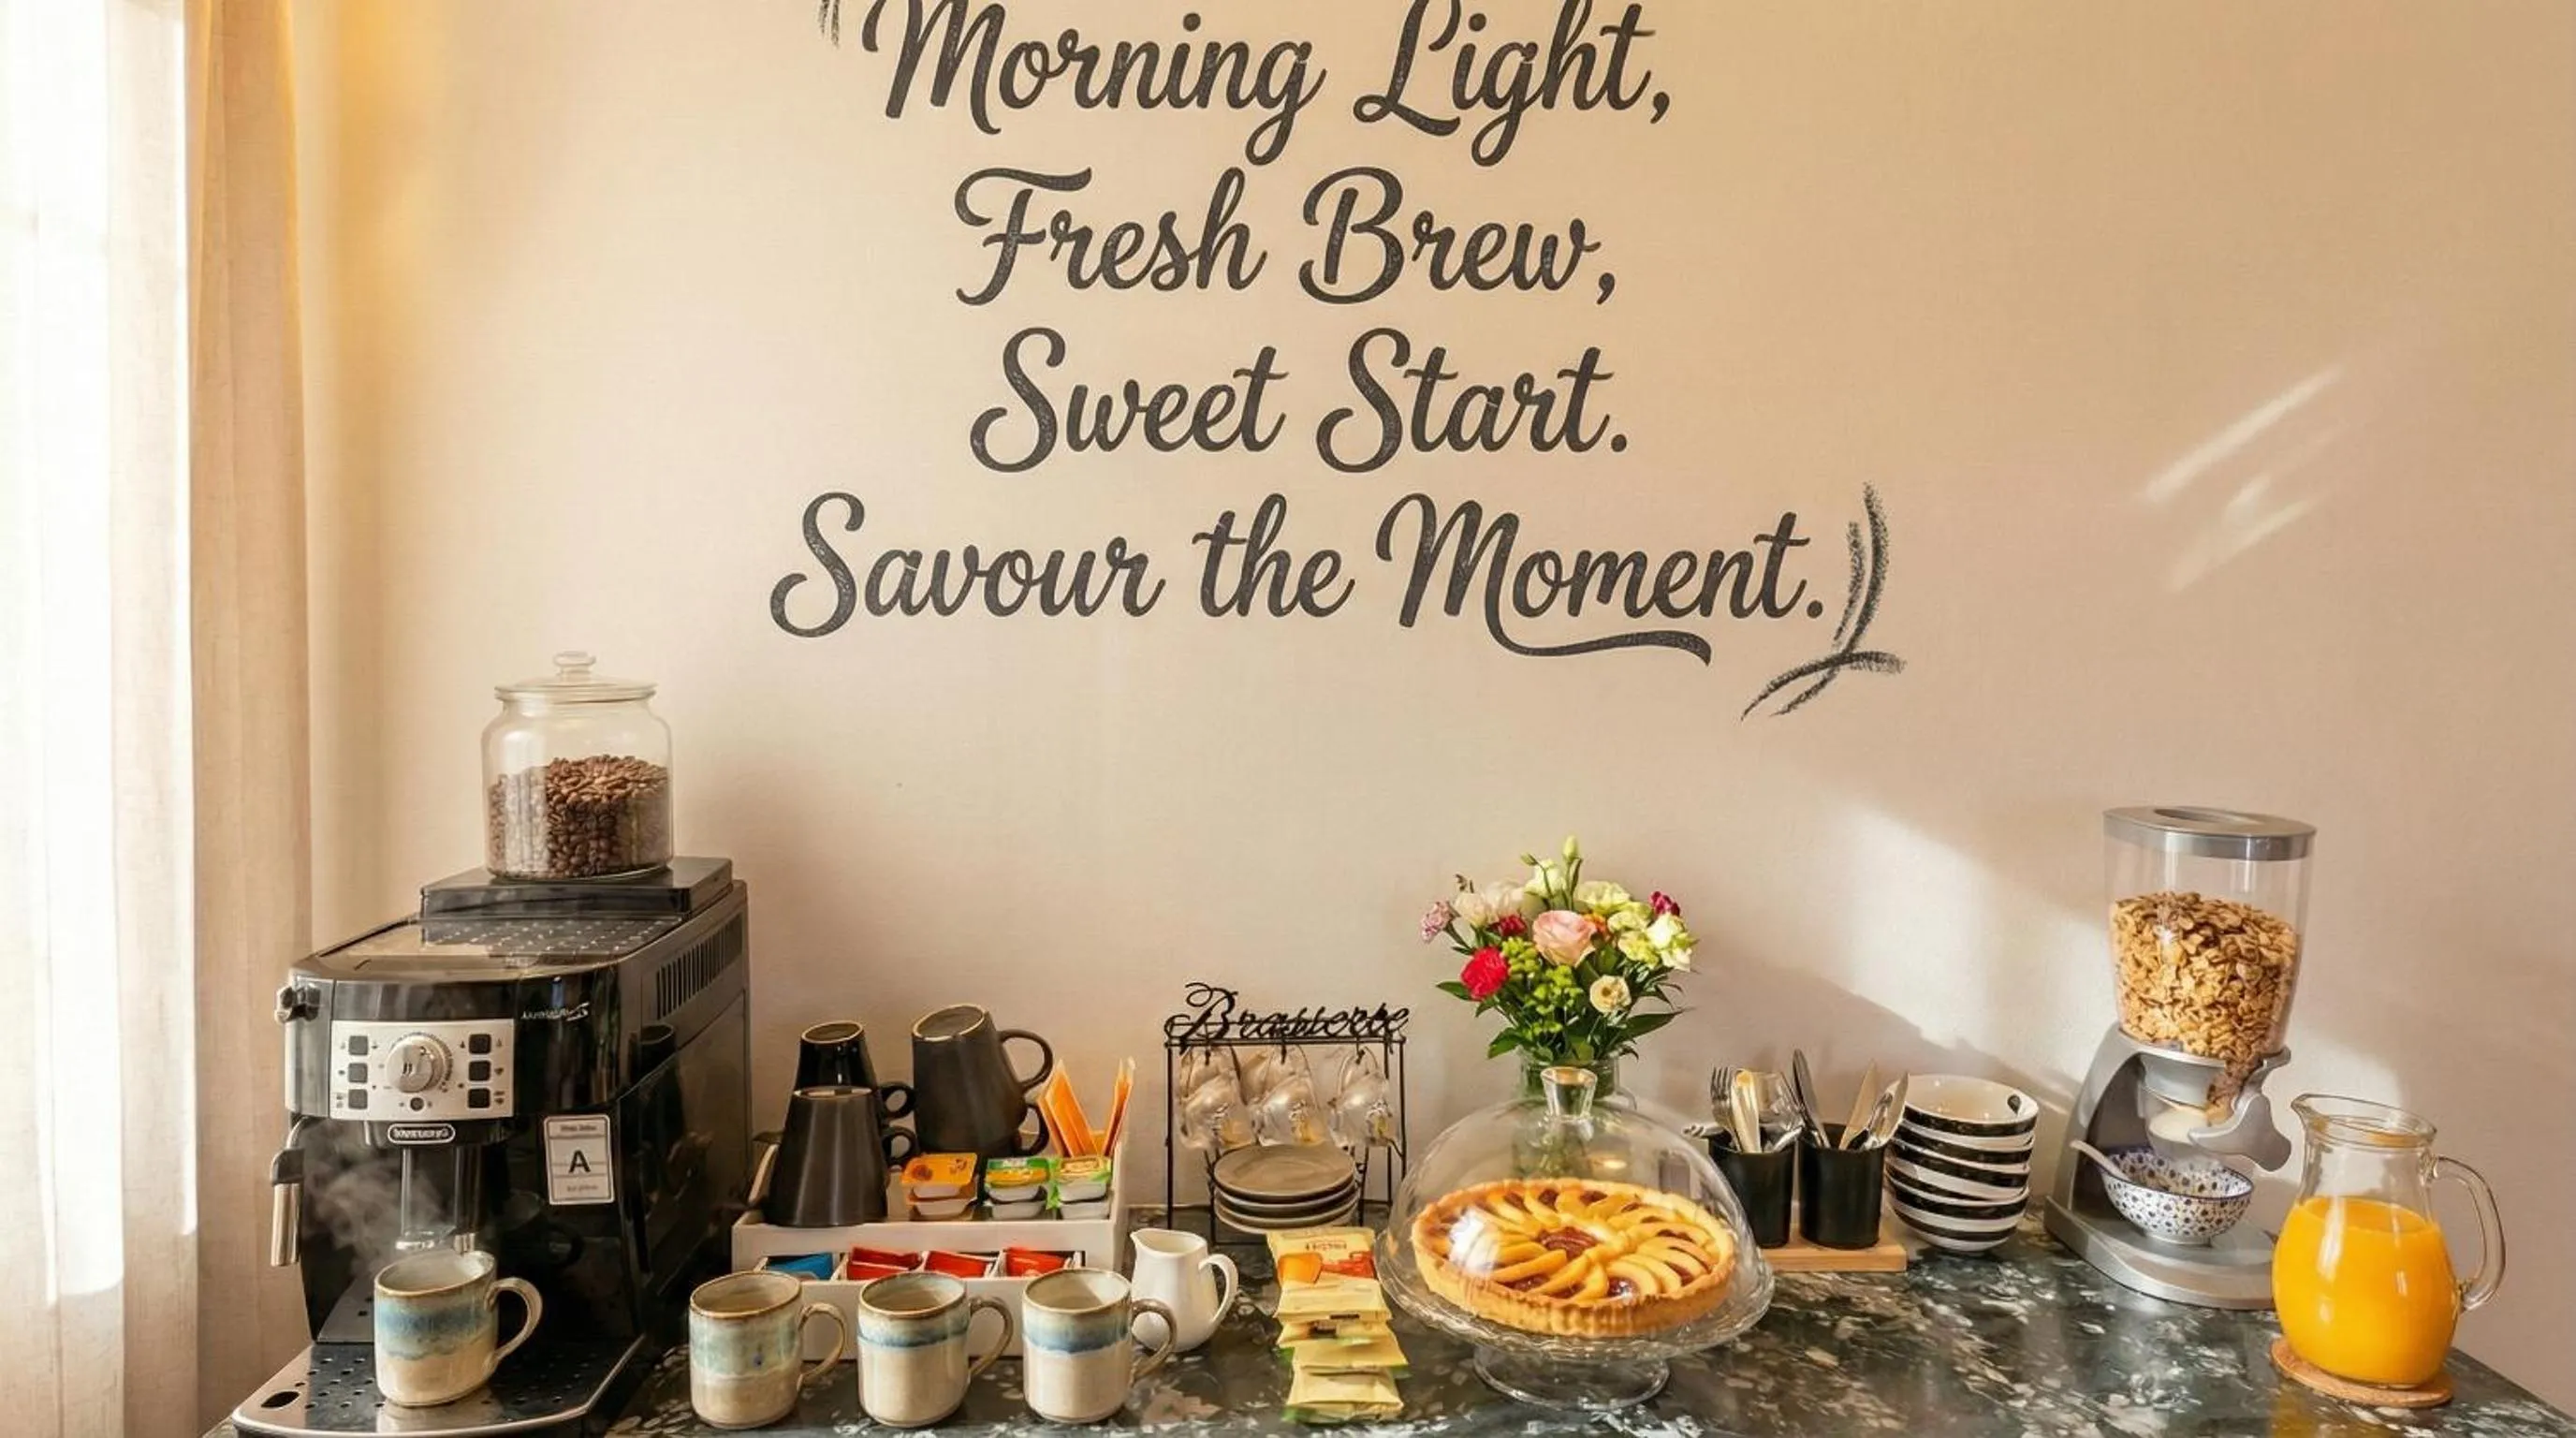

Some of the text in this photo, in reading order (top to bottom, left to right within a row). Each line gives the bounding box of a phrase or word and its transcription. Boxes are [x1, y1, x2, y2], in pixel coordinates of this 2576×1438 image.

[861, 0, 1671, 168] Morning Light,
[954, 167, 1616, 306] Fresh Brew,
[970, 327, 1628, 474] Sweet Start.
[770, 492, 1823, 667] Savour the Moment.
[568, 1150, 591, 1173] A
